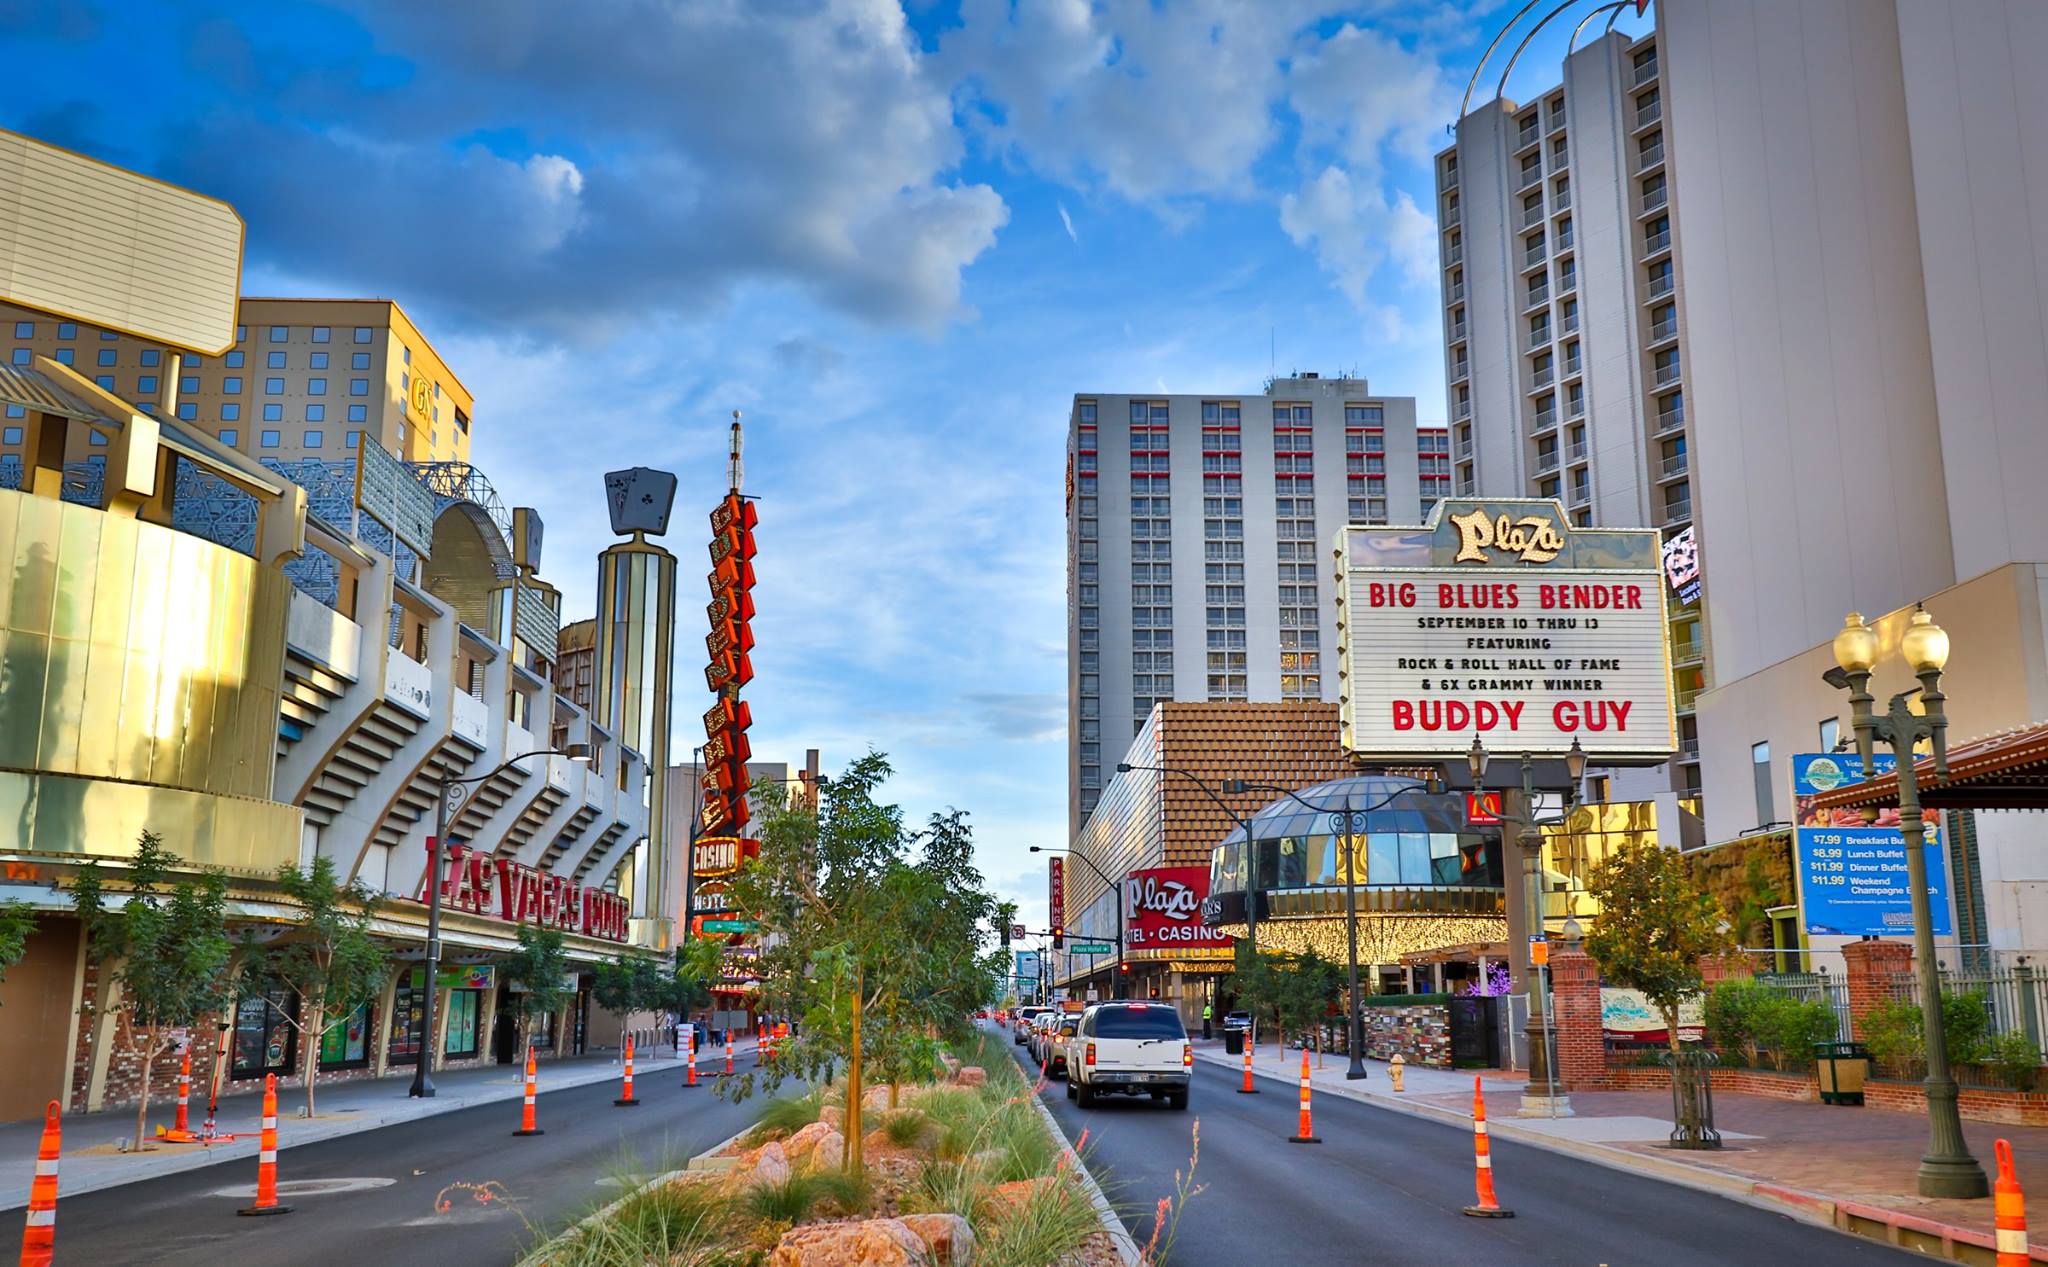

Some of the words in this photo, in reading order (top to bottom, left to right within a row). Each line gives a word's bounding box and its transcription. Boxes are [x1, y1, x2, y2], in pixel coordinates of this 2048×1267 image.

[1449, 508, 1565, 564] Plaza
[704, 496, 740, 692] GOLDEN
[1369, 582, 1416, 608] BIG
[1438, 582, 1519, 609] BLUES
[1540, 582, 1643, 610] BENDER
[1417, 616, 1505, 629] SEPTEMBER
[1513, 617, 1528, 629] 10
[1536, 617, 1577, 630] THRU
[1584, 617, 1599, 629] 13
[1467, 637, 1551, 650] FEATURING
[1398, 657, 1437, 670] ROCK
[1444, 657, 1454, 670] &
[1461, 657, 1500, 670] ROLL
[1508, 657, 1546, 670] HALL
[1554, 657, 1573, 670] OF
[1581, 657, 1620, 670] FAME
[1421, 678, 1431, 691] &
[1440, 678, 1460, 691] 6X
[1468, 678, 1534, 691] GRAMMY
[1543, 678, 1603, 691] WINNER
[1392, 699, 1525, 731] BUDDY
[1552, 700, 1633, 733] GUY
[1846, 836, 1889, 845] Breakfast
[694, 843, 735, 870] CASINO
[1847, 850, 1875, 859] Lunch
[1876, 850, 1904, 859] Buffet
[1849, 863, 1879, 872] Dinner
[1881, 863, 1908, 872] Buffet
[422, 836, 493, 914] LAS
[496, 859, 581, 931] VEGAS
[1849, 877, 1891, 885] Weekend
[1053, 859, 1062, 922] PARKING
[1851, 886, 1904, 896] Champagne
[1126, 876, 1200, 920] Plaza
[1158, 926, 1226, 941] CASINO
